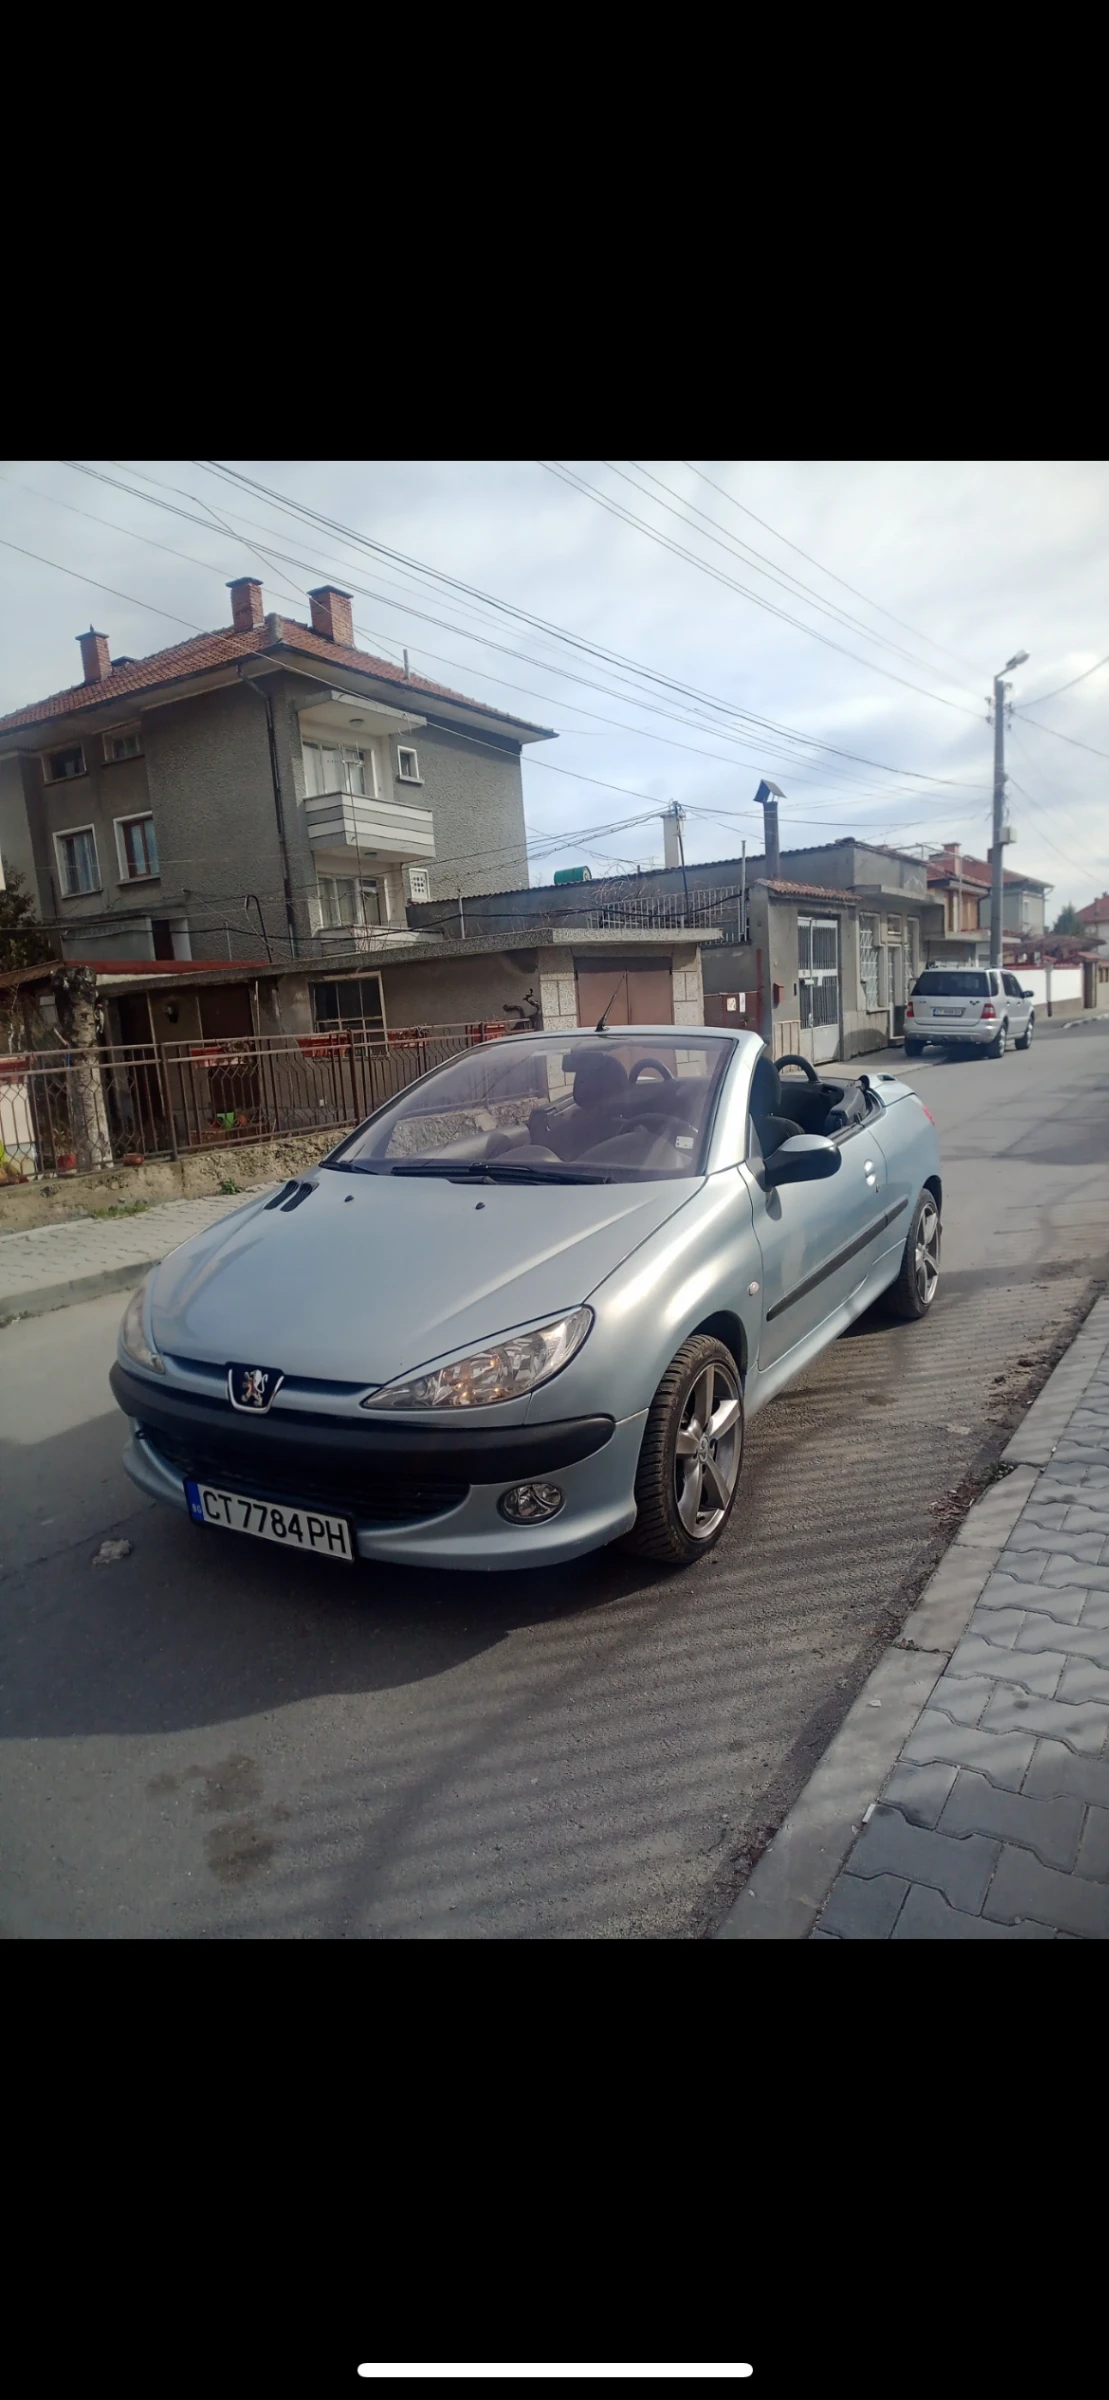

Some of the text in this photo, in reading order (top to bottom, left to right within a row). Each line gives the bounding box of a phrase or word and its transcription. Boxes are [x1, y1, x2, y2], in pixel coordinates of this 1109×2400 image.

[203, 1491, 347, 1554] CT 7784 PH
